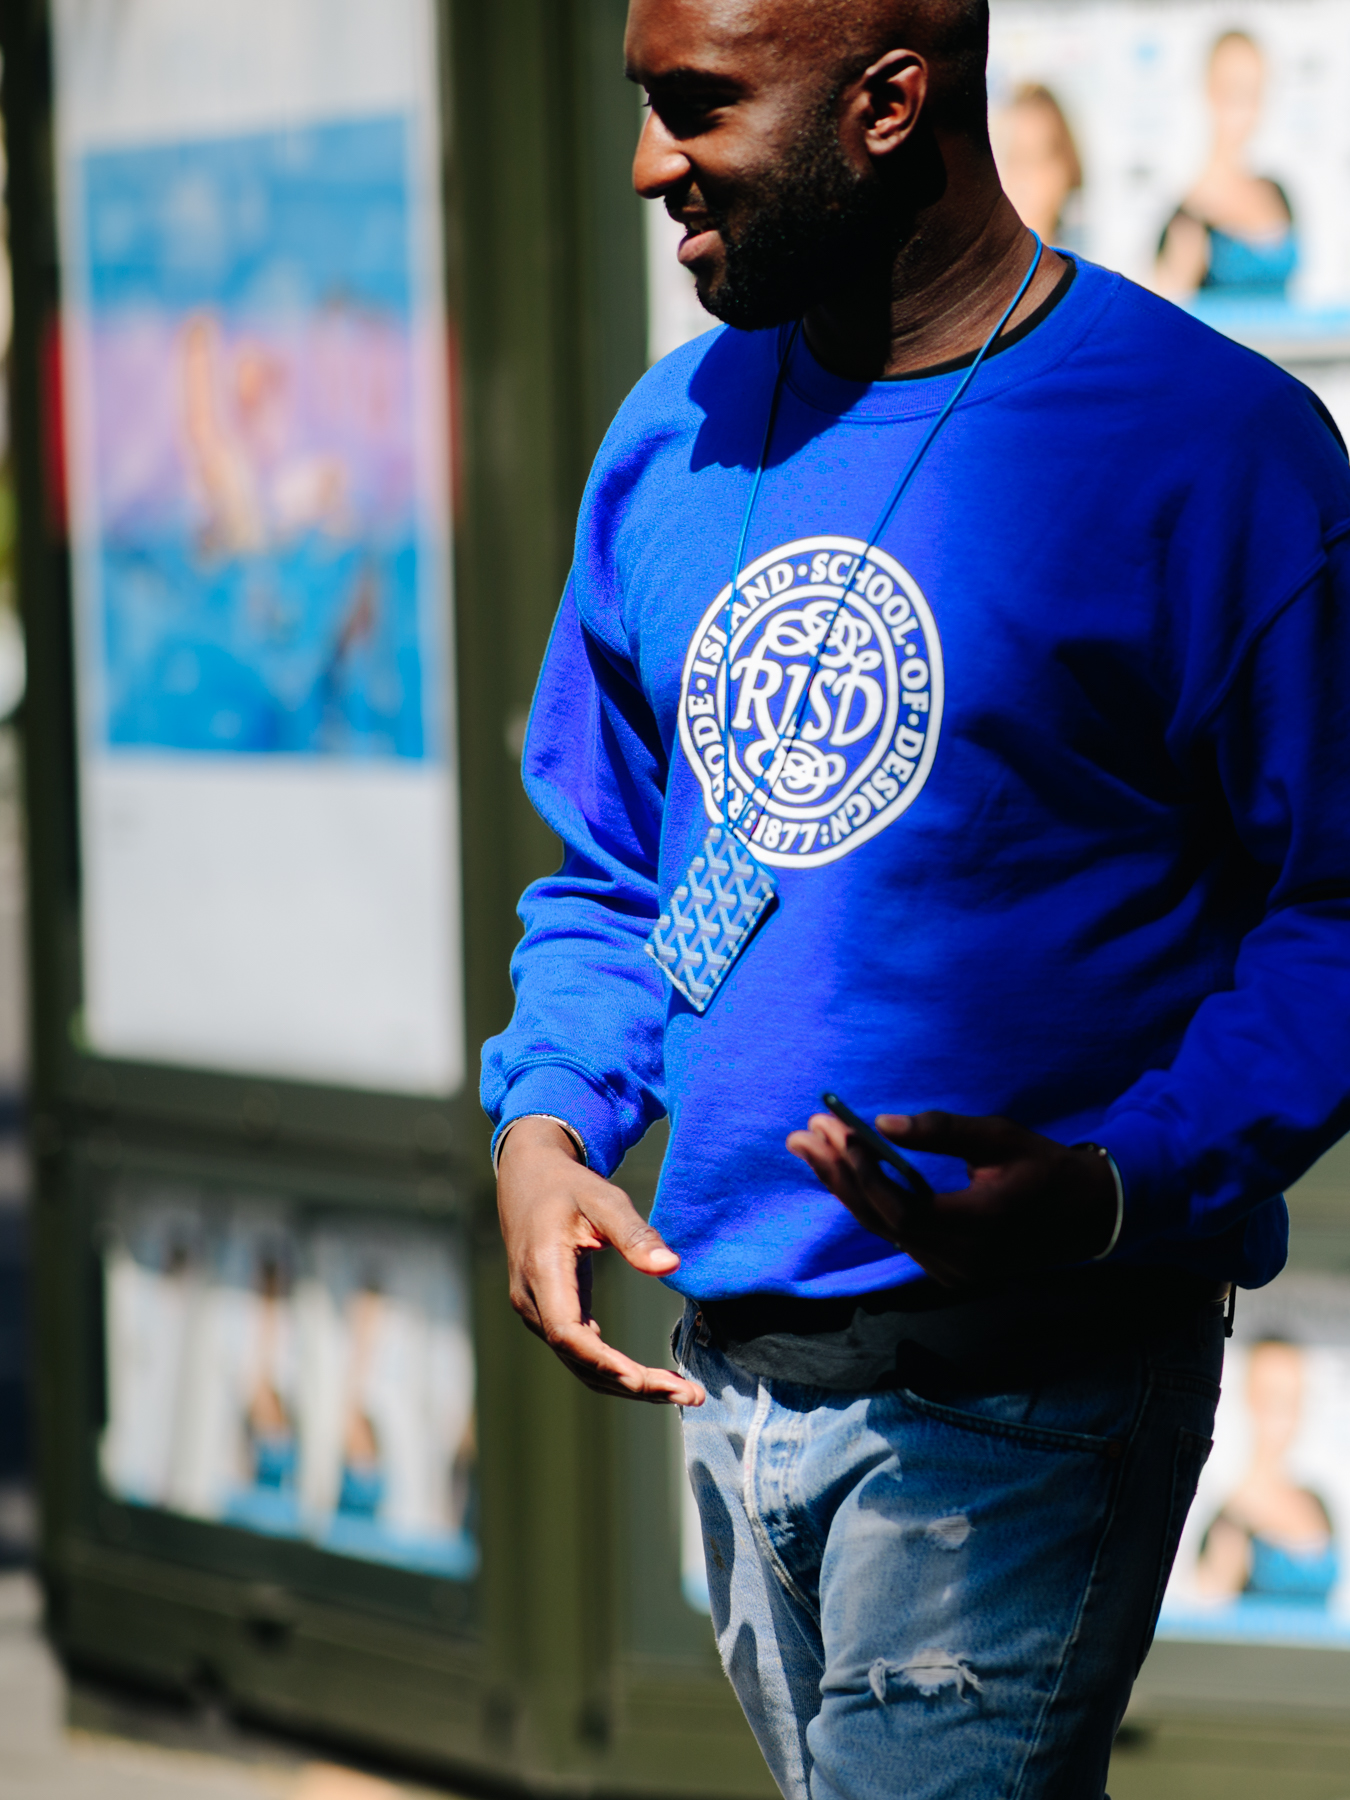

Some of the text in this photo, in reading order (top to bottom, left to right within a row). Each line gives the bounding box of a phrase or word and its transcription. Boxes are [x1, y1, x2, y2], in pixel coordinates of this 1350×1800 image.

[809, 551, 919, 648] SCHOOL
[730, 656, 884, 748] RISD
[899, 657, 930, 713] OF
[687, 692, 754, 827] RHODE
[829, 724, 925, 844] DESIGN
[751, 814, 820, 854] 1877
